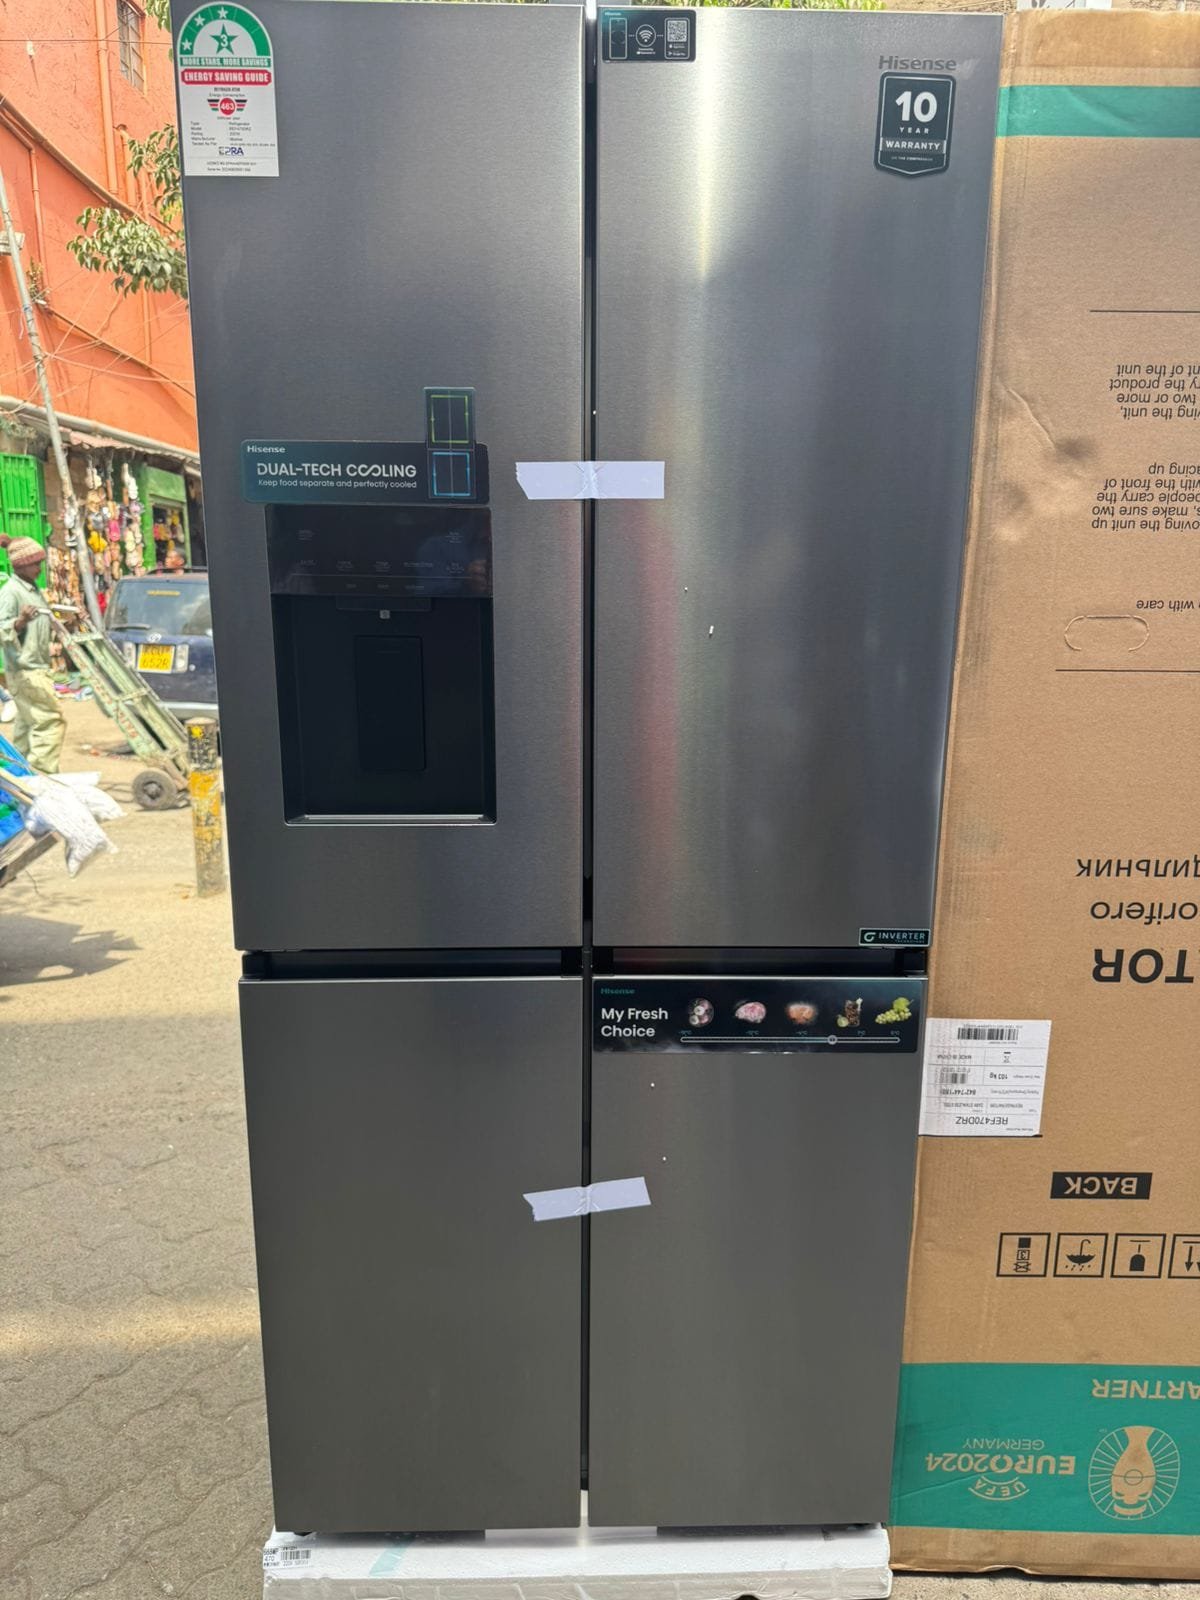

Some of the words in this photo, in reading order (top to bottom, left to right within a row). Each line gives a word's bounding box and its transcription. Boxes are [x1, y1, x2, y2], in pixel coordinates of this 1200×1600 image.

[220, 34, 228, 48] 3
[182, 57, 200, 66] MORE
[223, 58, 241, 66] MORE
[242, 58, 268, 67] SAVINGS
[878, 55, 956, 71] Hisense
[184, 72, 213, 82] ENERGY
[214, 72, 243, 82] SAVING
[245, 72, 268, 82] GUIDE
[896, 91, 938, 122] 10
[886, 140, 940, 150] WARRANTY
[1117, 365, 1142, 377] unit
[1146, 365, 1166, 377] the
[1169, 365, 1184, 377] of
[1110, 376, 1160, 392] product
[1164, 380, 1185, 392] the
[1116, 394, 1150, 403] more
[1154, 394, 1168, 403] or
[1173, 394, 1196, 406] two
[1120, 406, 1147, 420] unit,
[1152, 408, 1172, 420] the
[257, 463, 342, 476] DUAL-TECH
[1148, 462, 1165, 474] up
[259, 480, 278, 488] Keep
[299, 480, 334, 488] separate
[354, 480, 389, 489] perfectly
[390, 480, 416, 488] cooled
[1103, 479, 1117, 491] of
[1121, 479, 1151, 490] front
[1155, 479, 1176, 491] the
[1097, 493, 1117, 504] the
[1120, 490, 1154, 502] carry
[1092, 506, 1115, 517] two
[1119, 506, 1148, 516] sure
[1152, 506, 1188, 518] make
[1092, 517, 1108, 529] up
[1112, 520, 1135, 531] unit
[1140, 520, 1160, 532] the
[1136, 600, 1164, 610] care
[1168, 600, 1194, 612] with
[1090, 902, 1198, 925] orifero
[878, 932, 925, 940] INVERTER
[601, 1008, 625, 1022] My
[628, 1008, 668, 1020] Fresh
[601, 1024, 656, 1037] Choice
[956, 1116, 1008, 1125] REF470DRZ
[1064, 1176, 1138, 1195] BACK
[1092, 1379, 1200, 1400] ARTNER
[963, 1438, 1045, 1450] GERMANY
[974, 1480, 1027, 1497] UEFA
